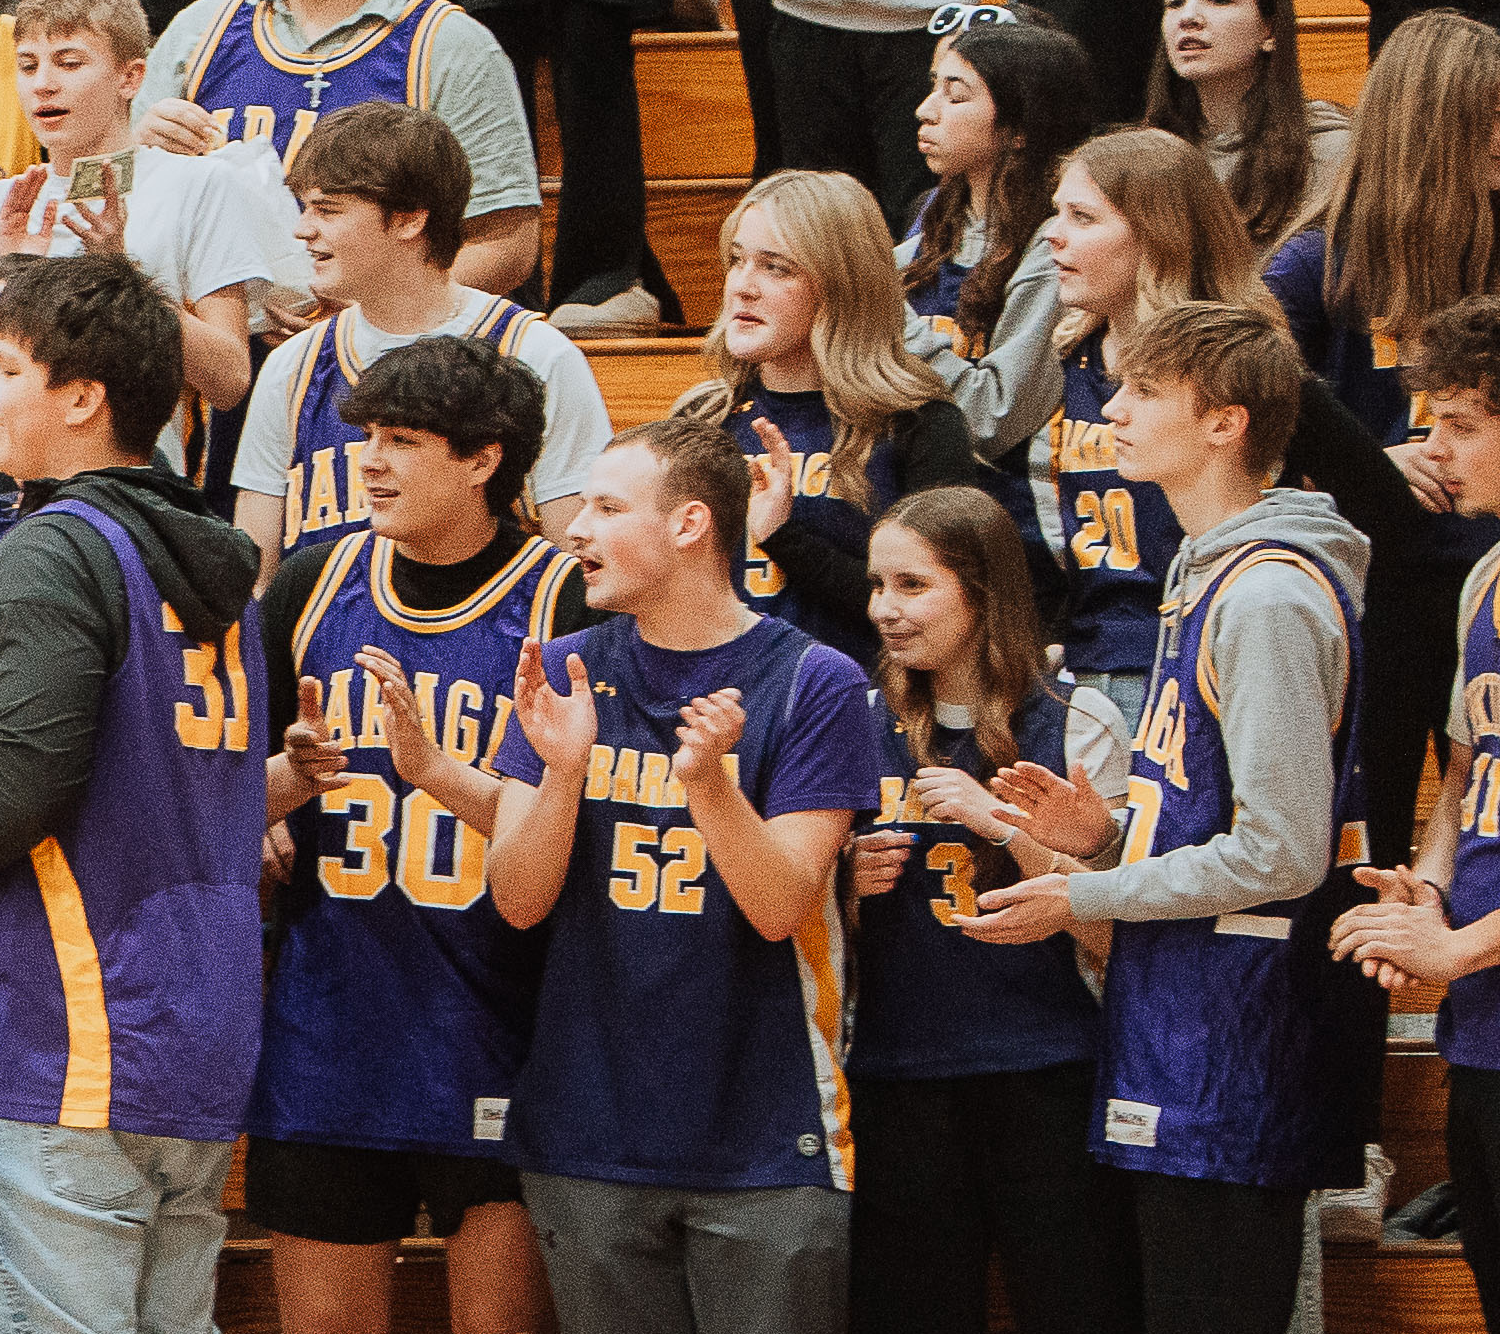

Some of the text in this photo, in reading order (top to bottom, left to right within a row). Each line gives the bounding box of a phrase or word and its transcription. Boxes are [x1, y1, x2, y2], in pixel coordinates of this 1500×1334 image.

[1071, 489, 1142, 570] 20
[317, 774, 488, 909] 30
[610, 824, 707, 915] 52
